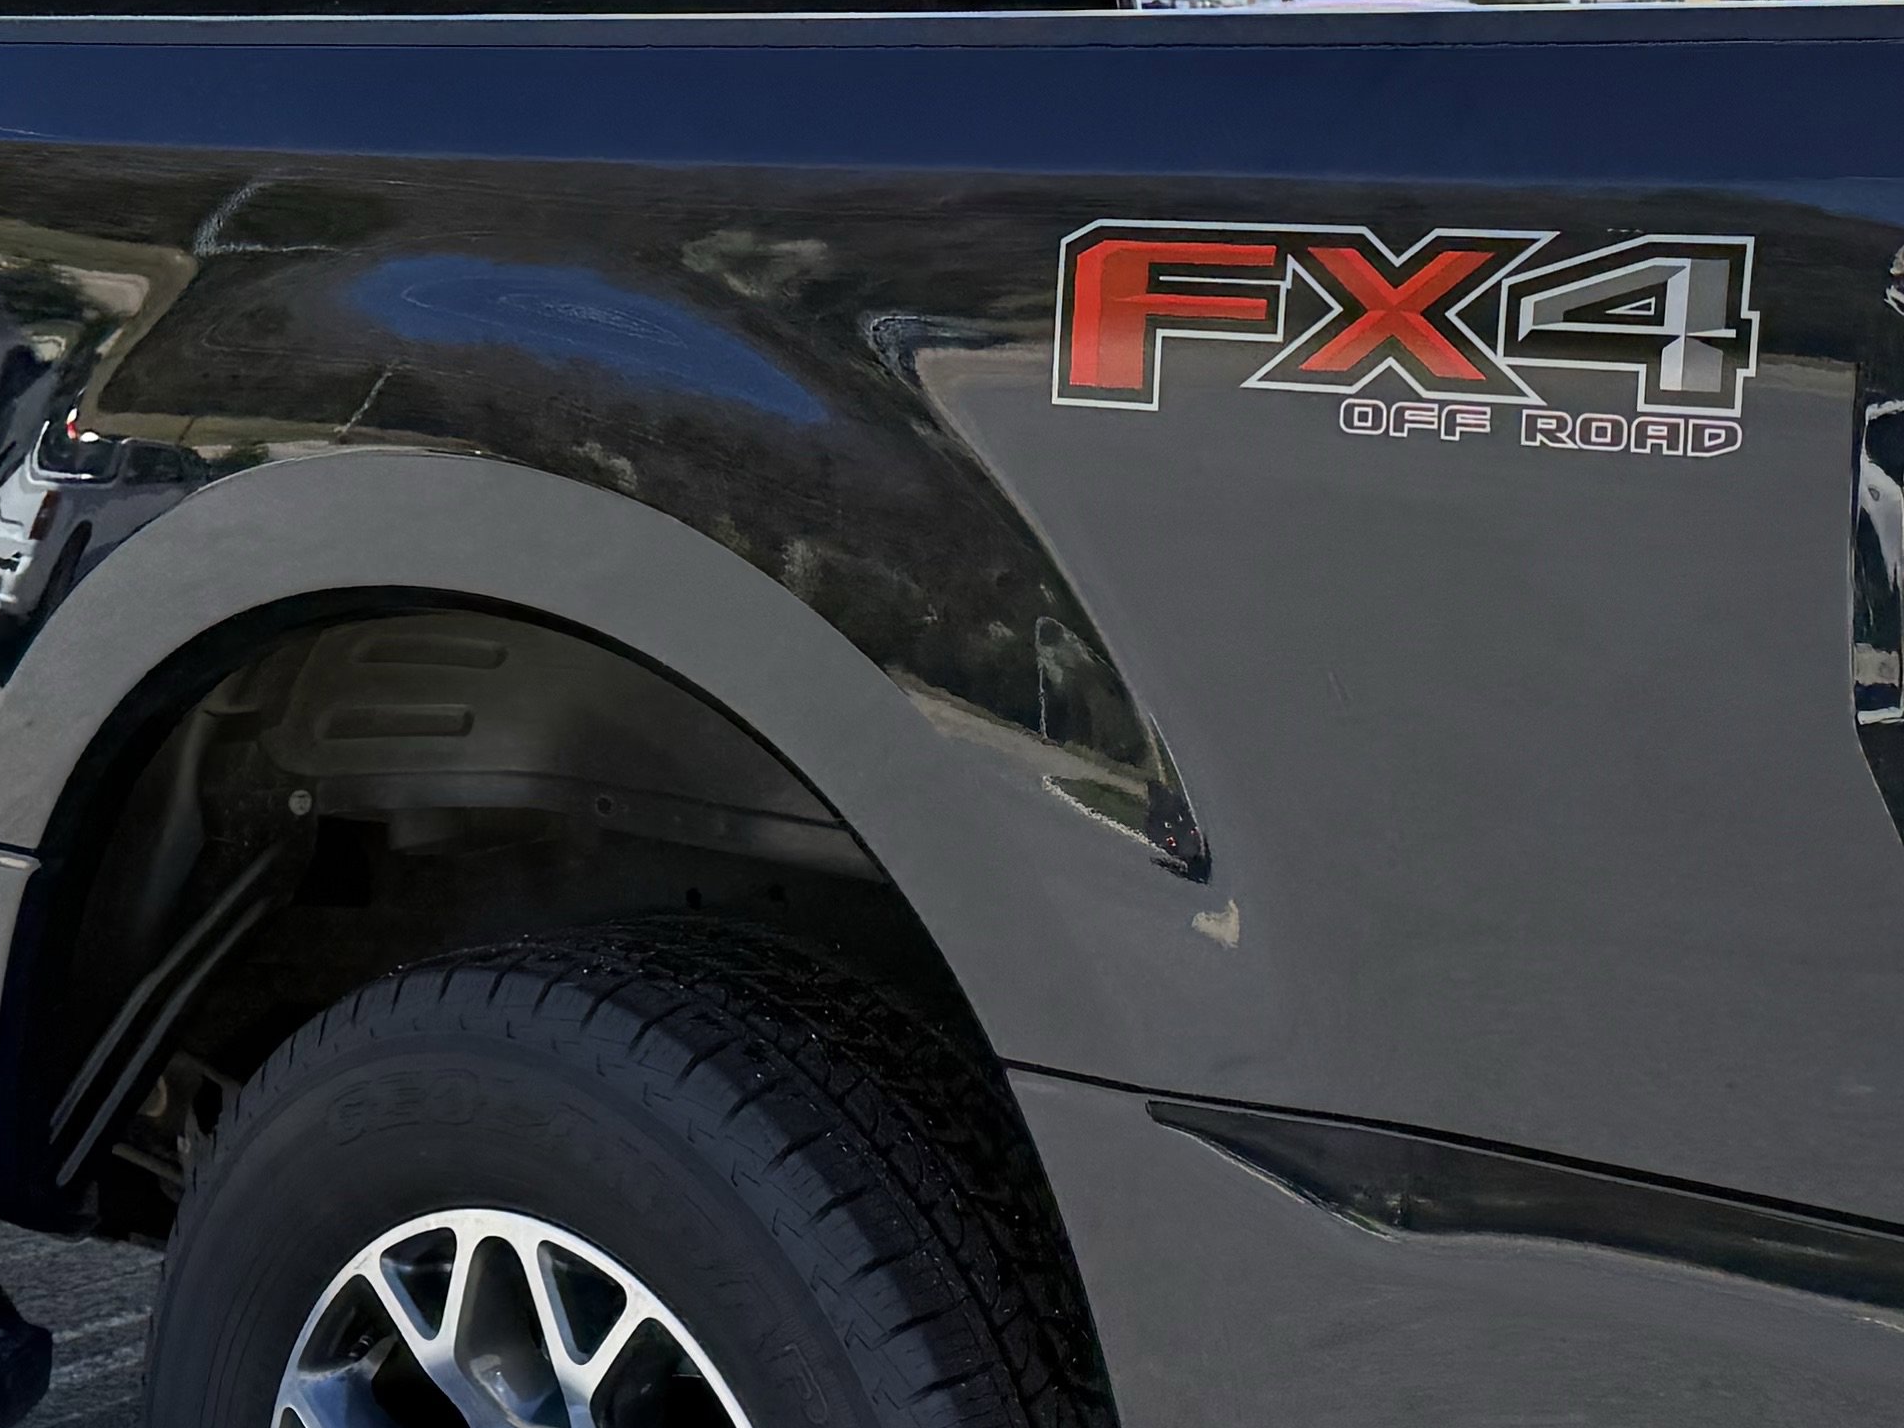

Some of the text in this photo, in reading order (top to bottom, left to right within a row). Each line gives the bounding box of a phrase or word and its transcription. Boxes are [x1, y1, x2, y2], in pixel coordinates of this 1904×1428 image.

[1052, 218, 1760, 417] FX4
[1339, 398, 1743, 458] OFF ROAD
